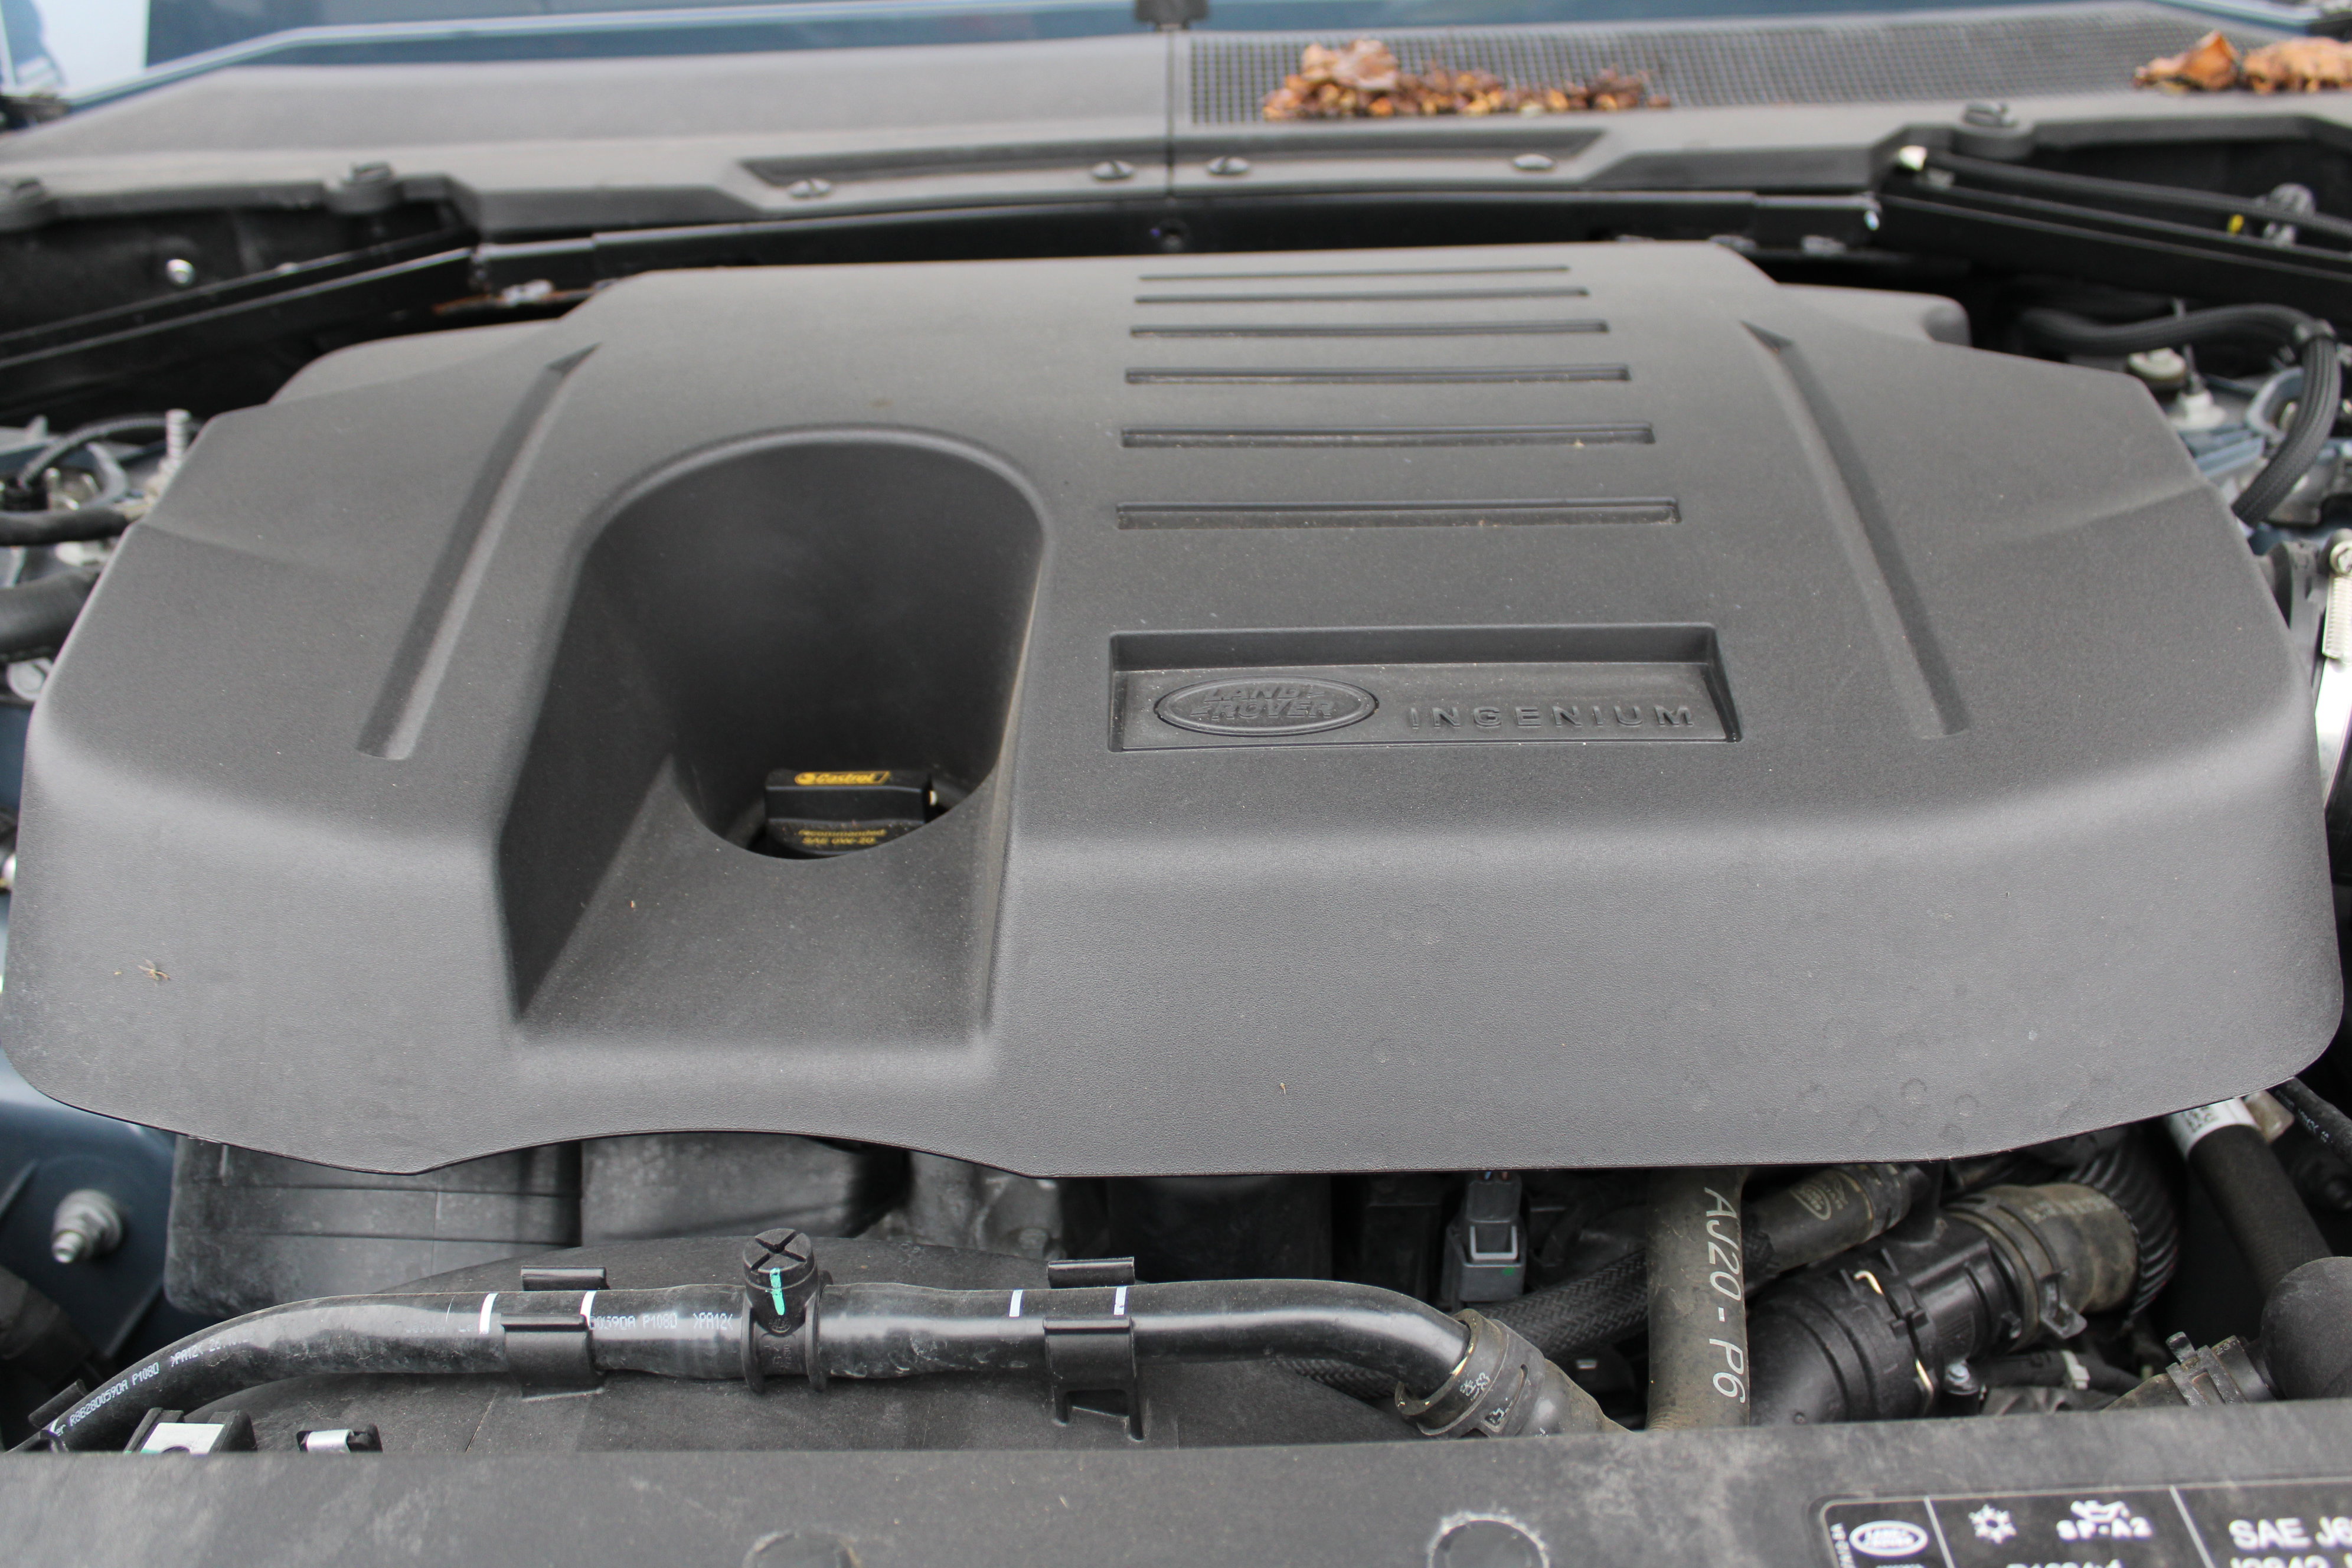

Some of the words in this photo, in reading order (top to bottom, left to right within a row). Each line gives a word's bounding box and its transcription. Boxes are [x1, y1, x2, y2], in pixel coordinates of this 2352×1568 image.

[1204, 686, 1302, 703] LAND
[1211, 699, 1334, 720] ROVER
[1409, 704, 1694, 730] INGENIUM
[815, 773, 876, 784] Castrol
[1704, 1187, 1742, 1301] AJ20
[1709, 1338, 1746, 1404] P6
[2228, 1517, 2313, 1550] SAE
[2314, 1515, 2352, 1549] J6
